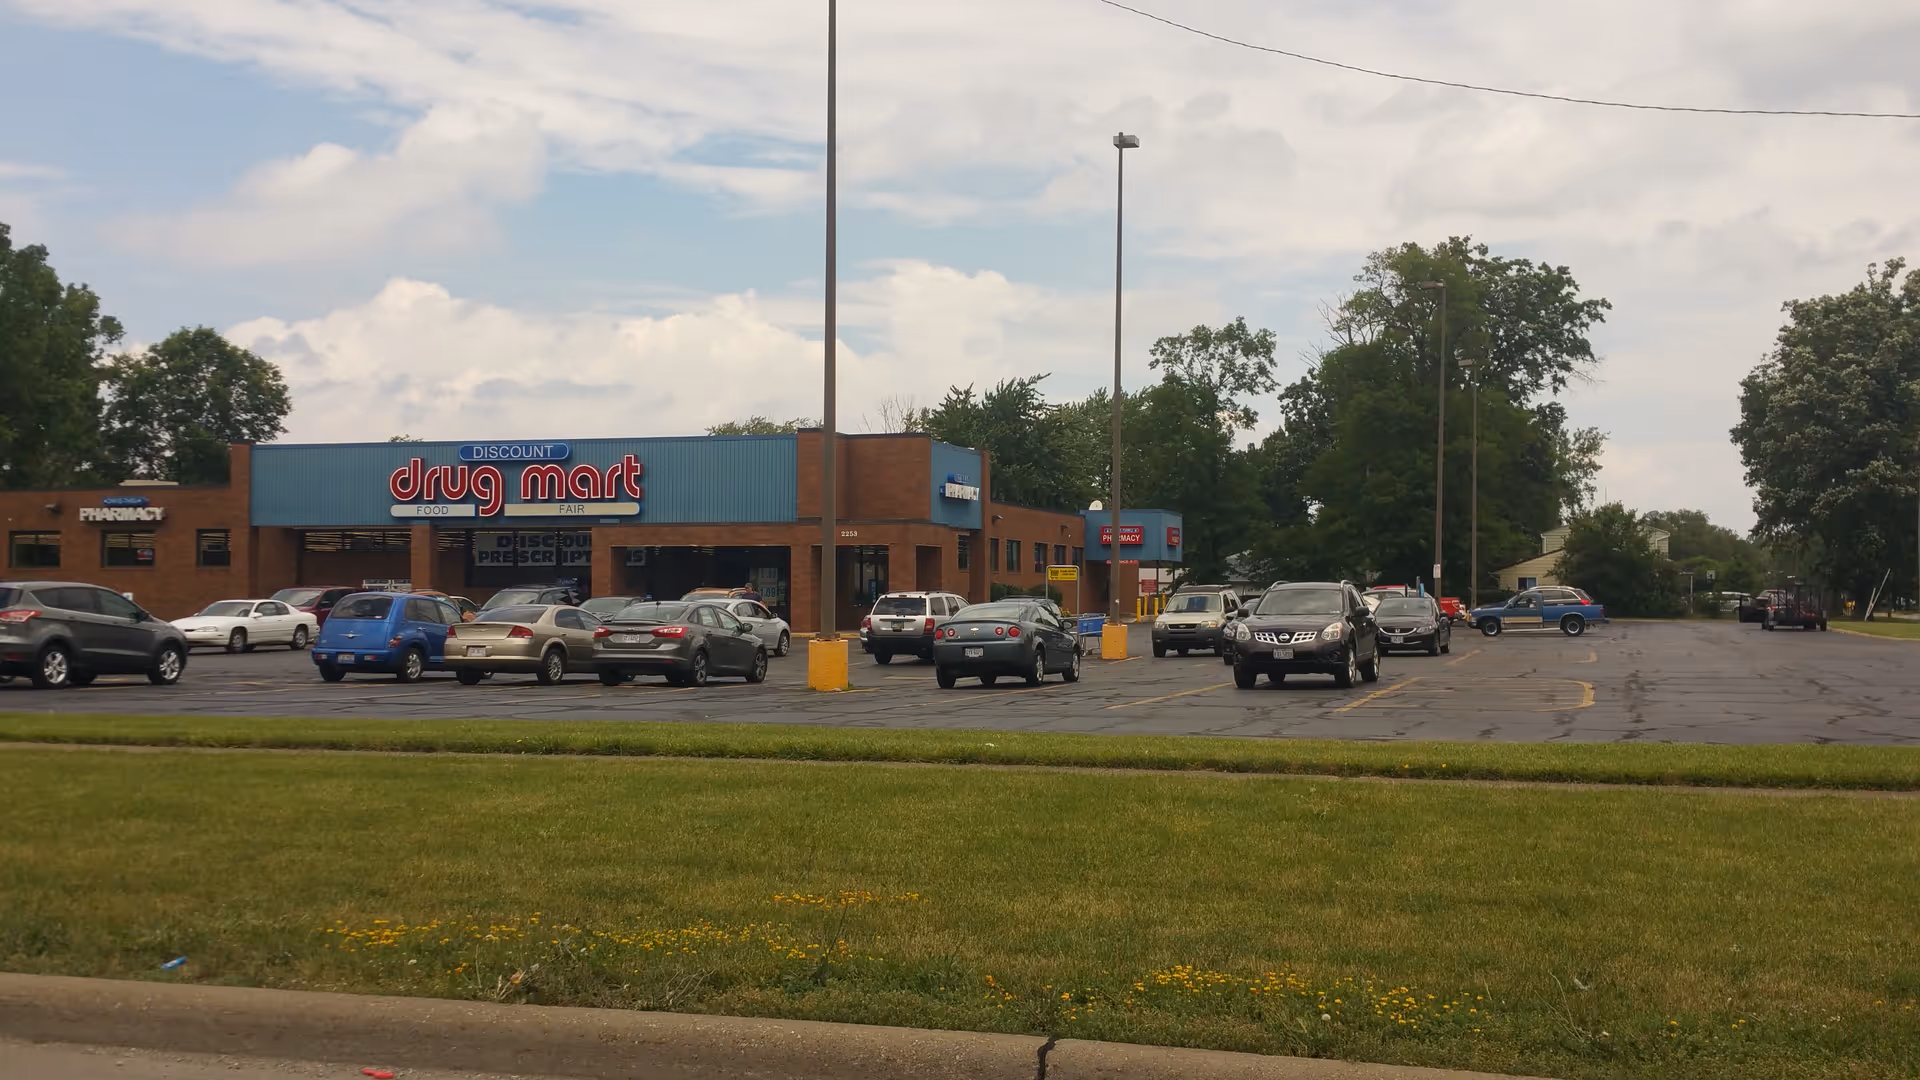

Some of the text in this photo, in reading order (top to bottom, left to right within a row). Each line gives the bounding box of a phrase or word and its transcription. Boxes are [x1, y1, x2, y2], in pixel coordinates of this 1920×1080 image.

[473, 445, 554, 459] DISCOUNT
[389, 454, 641, 517] drug mart
[80, 507, 164, 521] PHARMACY
[416, 504, 585, 515] FOOD FAIR
[496, 535, 592, 548] DISCOU
[1102, 534, 1141, 542] PHMACY
